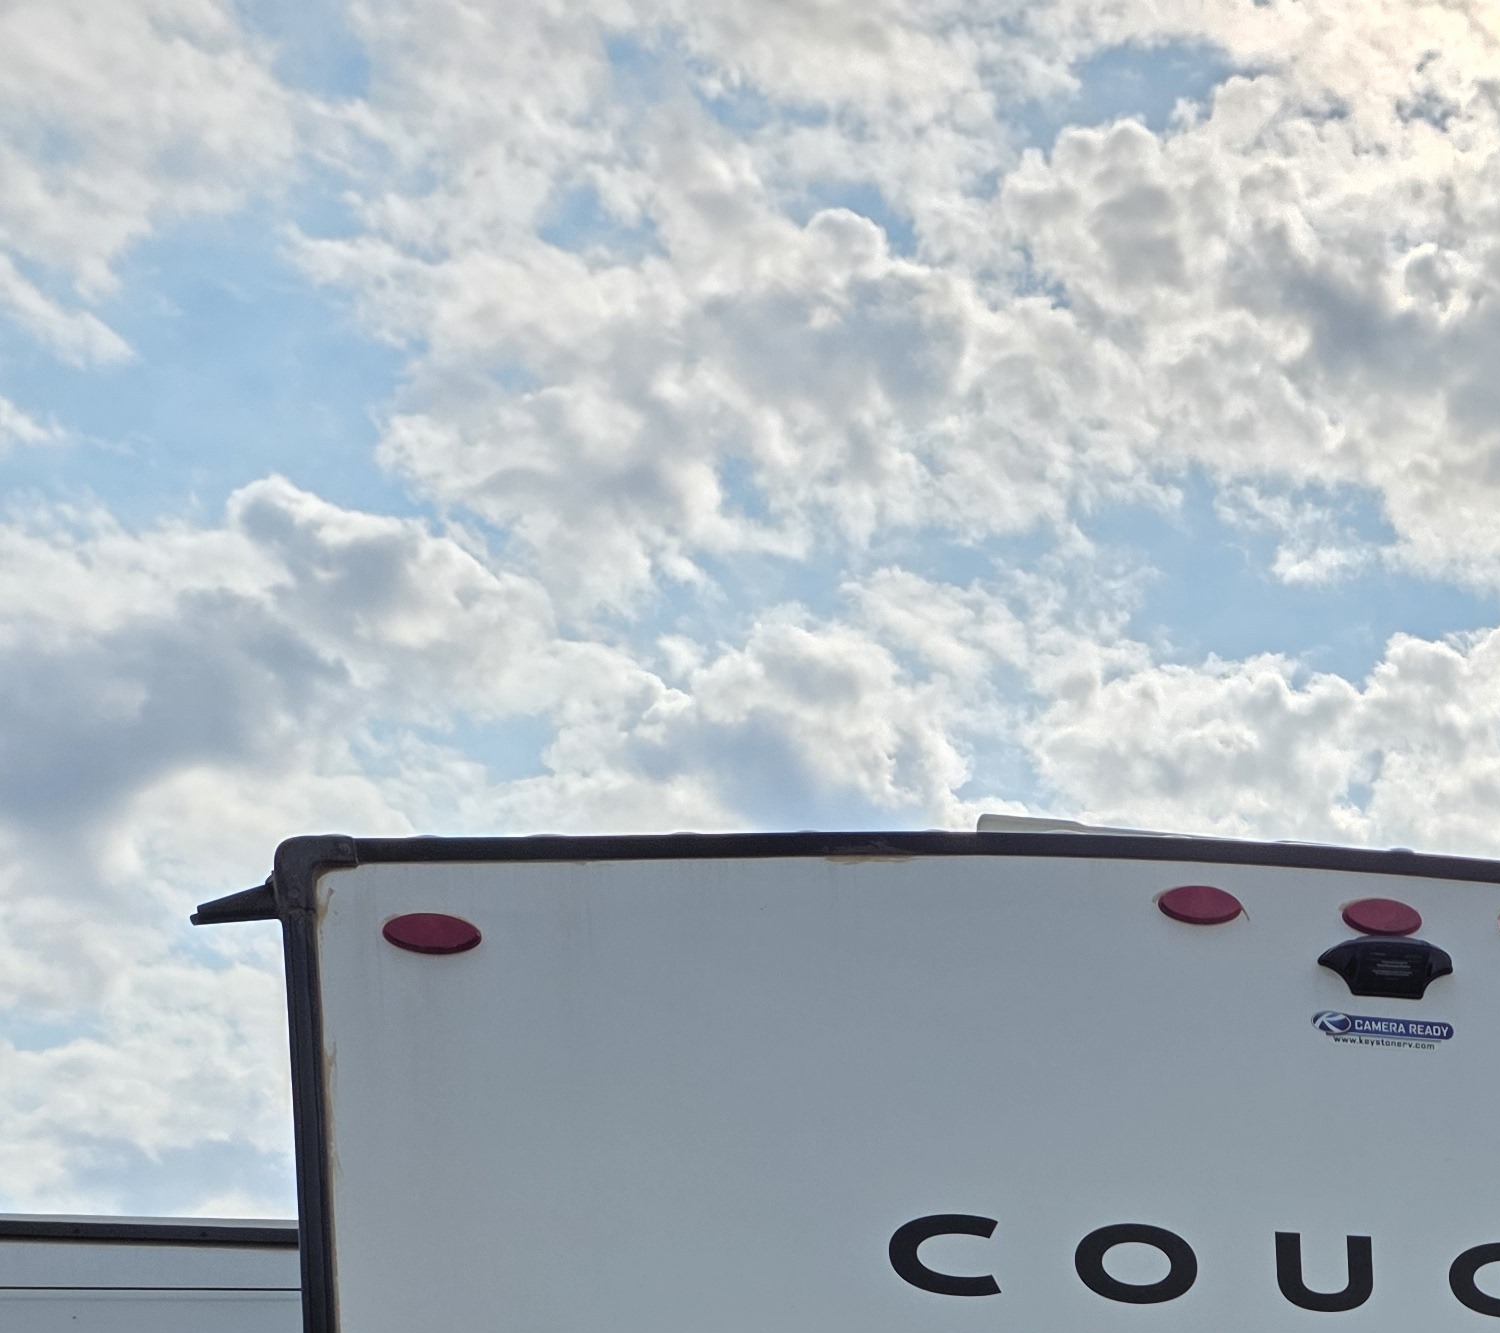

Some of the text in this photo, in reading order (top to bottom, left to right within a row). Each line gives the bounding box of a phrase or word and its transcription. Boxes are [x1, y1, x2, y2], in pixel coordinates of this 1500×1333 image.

[1354, 1019, 1406, 1034] CAMERA
[1409, 1023, 1449, 1037] READY
[1333, 1035, 1435, 1050] www.keystonerv.com
